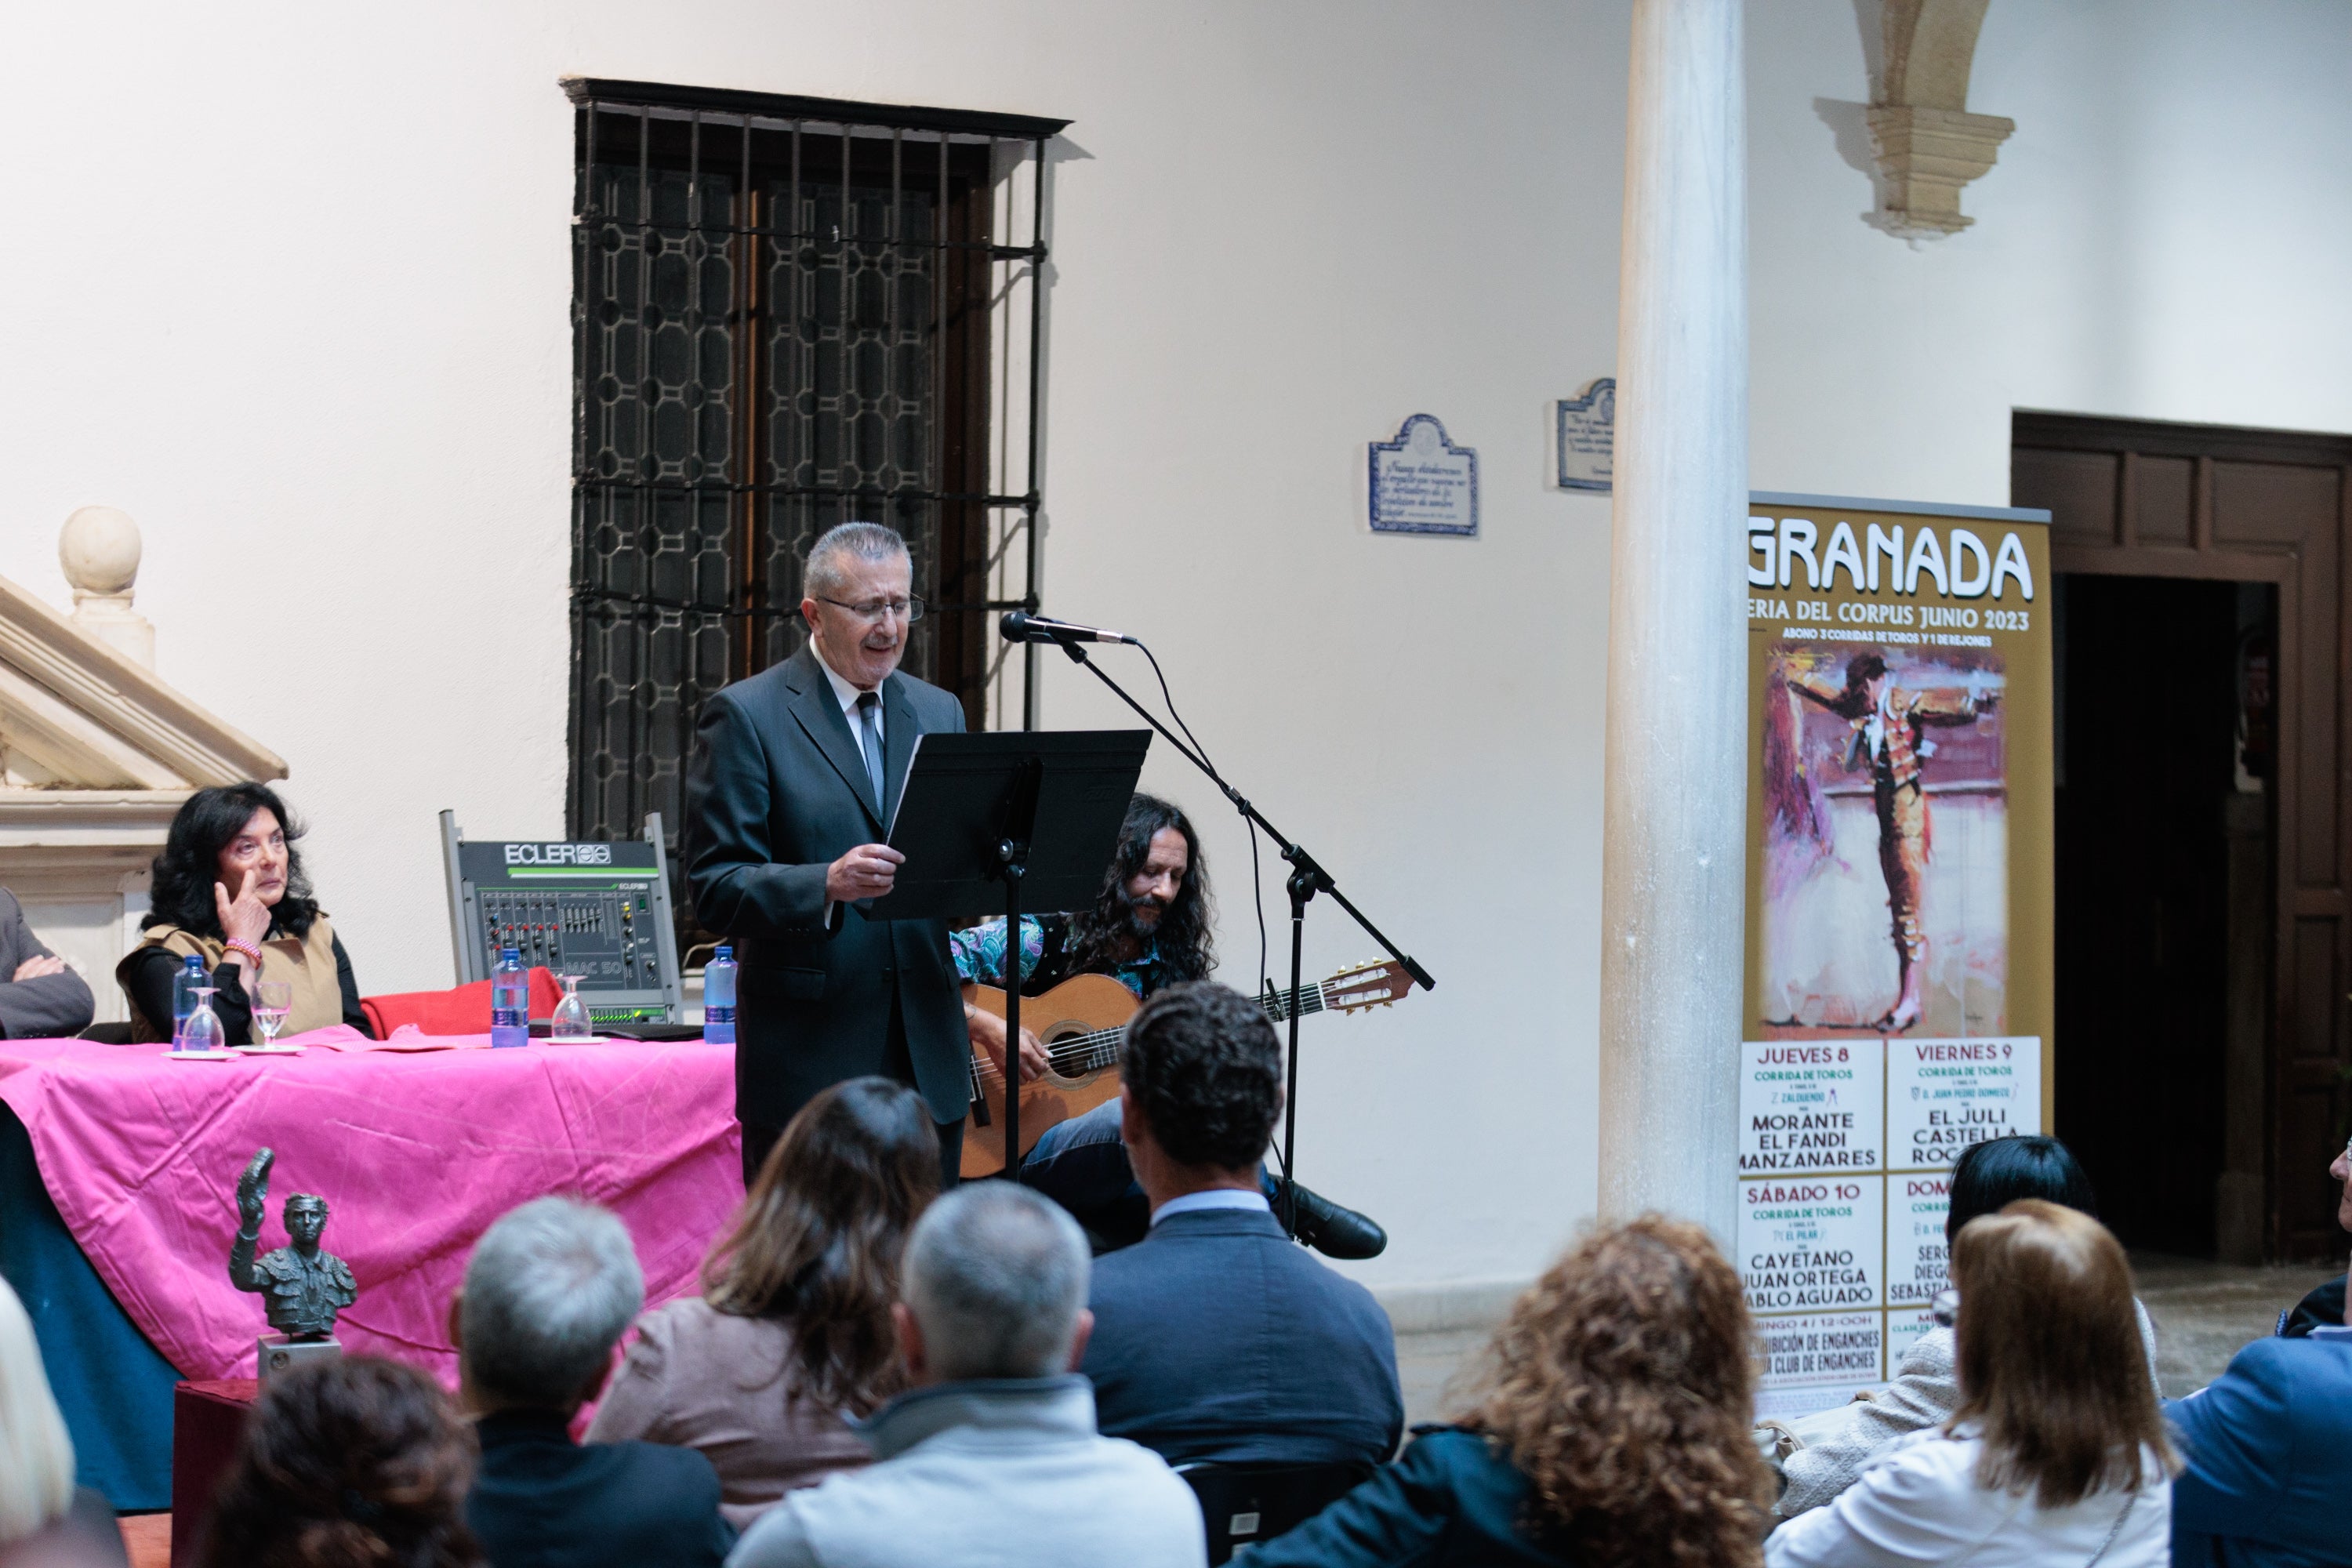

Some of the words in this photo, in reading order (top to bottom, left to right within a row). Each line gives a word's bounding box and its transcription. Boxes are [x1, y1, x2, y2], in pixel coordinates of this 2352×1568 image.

[1748, 516, 2034, 601] GRANADA
[1797, 600, 1832, 622] DEL
[1838, 603, 1914, 626] CORPUS
[1918, 606, 1979, 629] JUNIO
[1984, 609, 2030, 630] 2023
[1782, 627, 1818, 639] ABONO
[1820, 629, 1828, 640] 3
[1828, 630, 1875, 641] CORRIDAS
[1875, 631, 1887, 642] DE
[1888, 632, 1919, 644] TOROS
[1921, 633, 1929, 644] Y
[1930, 633, 1936, 644] 1
[1937, 634, 1948, 645] DE
[1949, 635, 1992, 648] REJONES
[505, 844, 577, 865] ECLER
[566, 961, 597, 974] MAC
[601, 961, 622, 974] 50
[1757, 1047, 1832, 1064] JUEVES
[1838, 1047, 1849, 1062] 8
[1915, 1044, 1998, 1061] VIERNES
[2002, 1044, 2013, 1059] 9
[1755, 1070, 1801, 1081] CORRIDA
[1804, 1070, 1814, 1080] DE
[1817, 1069, 1853, 1080] TOROS
[1918, 1066, 1962, 1077] CORRIDA
[1965, 1066, 1975, 1076] DE
[1978, 1065, 2013, 1076] TOROS
[1752, 1112, 1854, 1131] MORANTE
[1929, 1109, 1953, 1126] EL
[1958, 1108, 2006, 1124] JULI
[1760, 1134, 1783, 1150] EL
[1788, 1131, 1846, 1149] FANDI
[1748, 1181, 1828, 1203] SÁBADO
[1835, 1184, 1860, 1200] 10
[1753, 1209, 1800, 1220] CORRIDA
[1802, 1208, 1813, 1218] DE
[1816, 1207, 1853, 1218] TOROS
[1785, 1231, 1794, 1240] EL
[1796, 1229, 1818, 1240] PILAR
[1751, 1250, 1853, 1269] CAYETANO
[1793, 1268, 1867, 1287] ORTEGA
[1796, 1287, 1873, 1305] AGUADO
[1801, 1319, 1808, 1328] 4
[1807, 1334, 1819, 1352] DE
[1822, 1330, 1879, 1350] ENGANCHES
[1775, 1355, 1799, 1374] CLUB
[1802, 1354, 1814, 1372] DE
[1818, 1350, 1875, 1370] ENGANCHES
